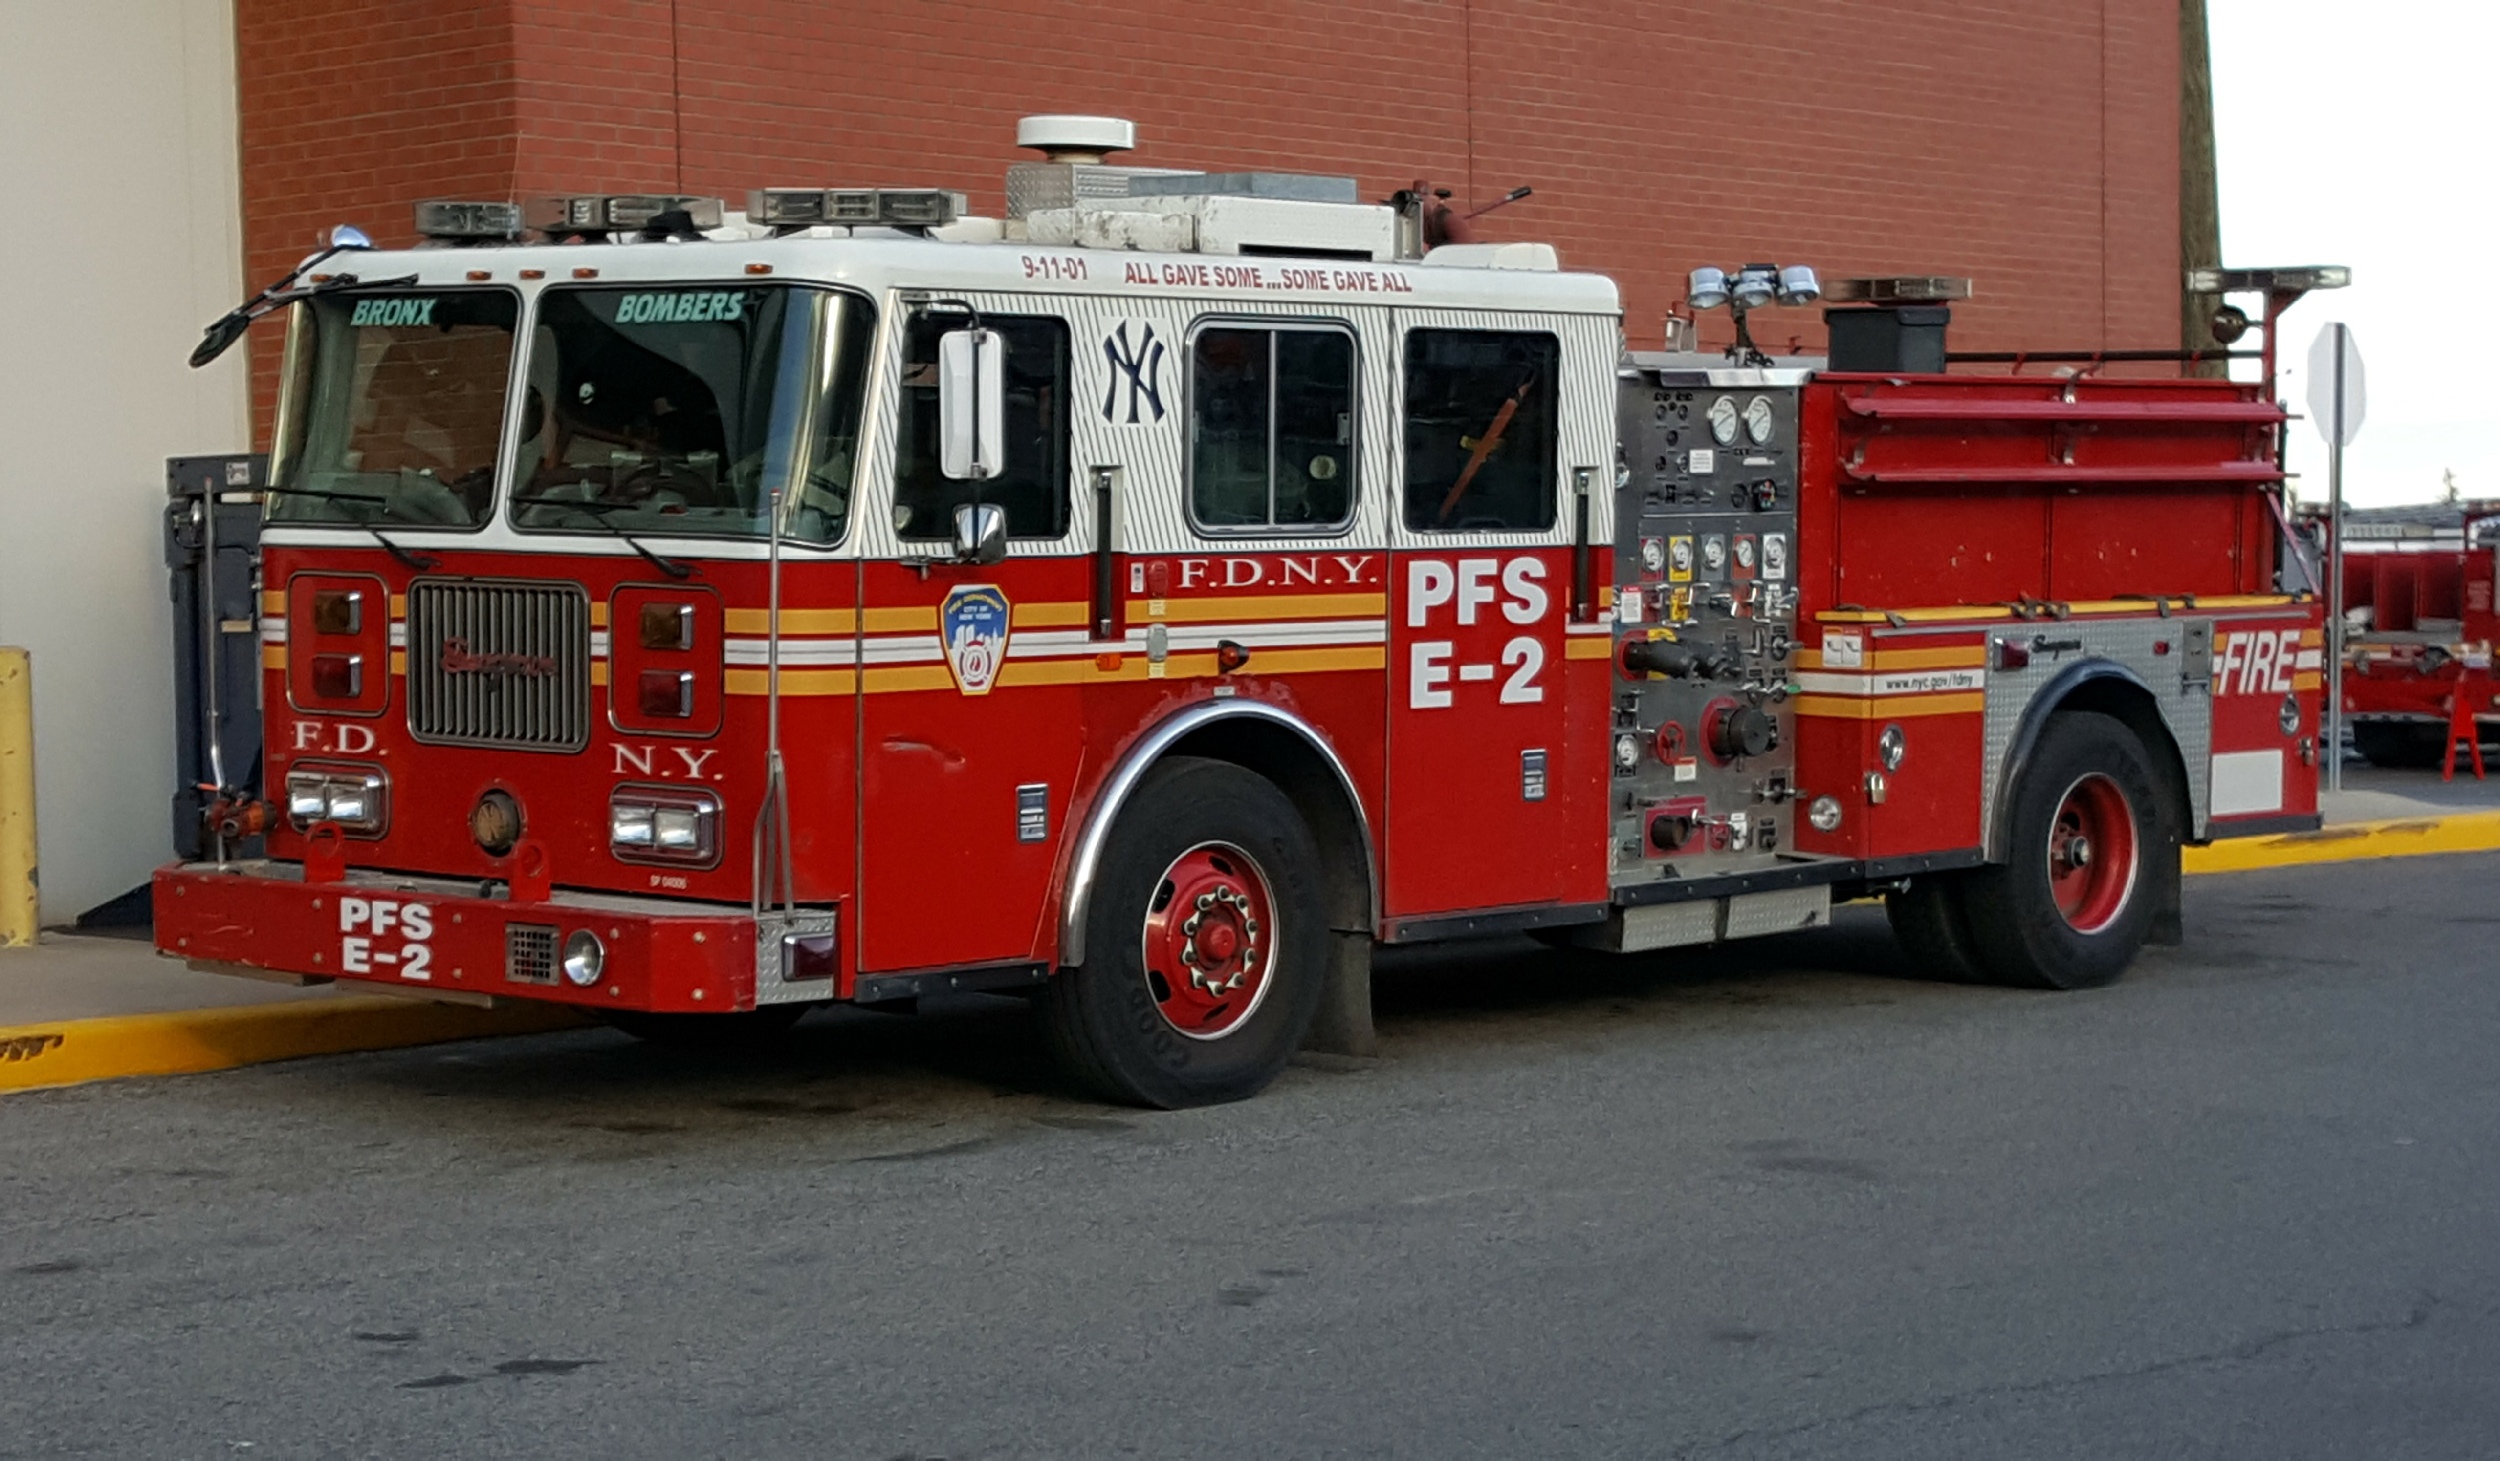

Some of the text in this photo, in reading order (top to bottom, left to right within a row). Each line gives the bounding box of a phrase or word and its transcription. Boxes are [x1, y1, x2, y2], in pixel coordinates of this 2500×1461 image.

[1021, 256, 1088, 281] 9-11-01
[1125, 262, 1158, 284] ALL
[1162, 264, 1210, 287] GAVE
[1213, 265, 1263, 288] SOME
[1333, 271, 1379, 292] GAVE
[1382, 272, 1413, 292] ALL
[350, 299, 437, 326] BRONX
[615, 292, 745, 323] BOMBERS
[1102, 318, 1165, 424] NY
[1177, 556, 1378, 588] F.D.N.Y.
[1408, 556, 1548, 627] PFS
[1409, 636, 1545, 710] E-2
[2217, 629, 2302, 696] FIRE
[291, 720, 388, 757] F.D.
[609, 743, 724, 780] N.Y.
[340, 896, 433, 941] PFS
[343, 936, 431, 980] E-2
